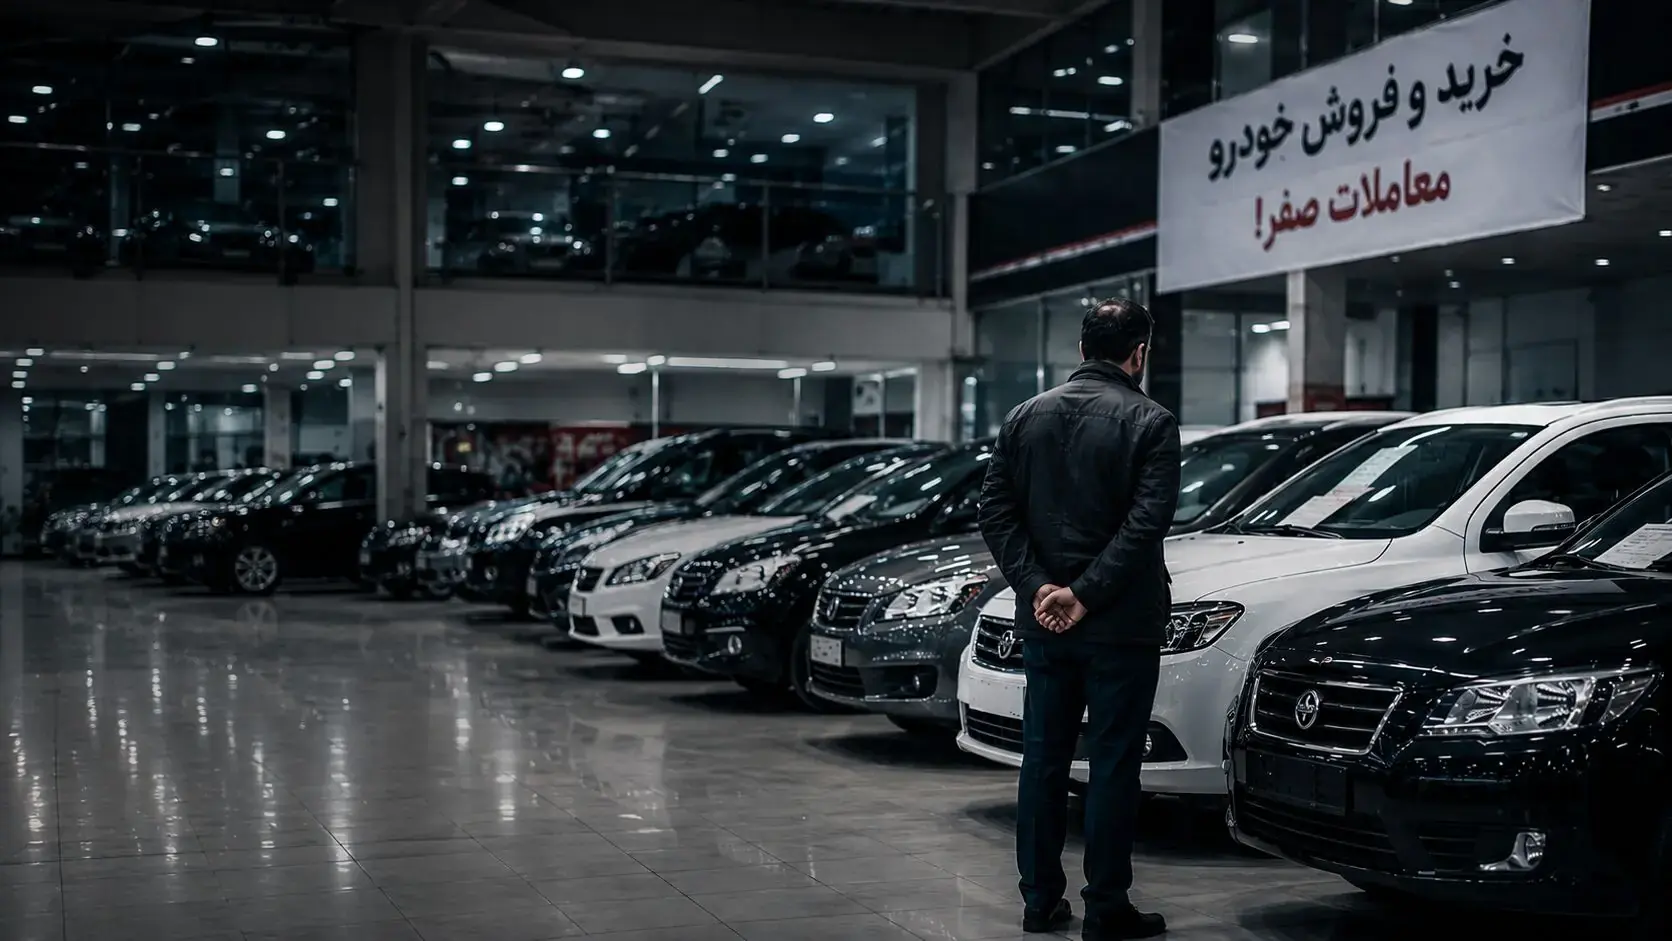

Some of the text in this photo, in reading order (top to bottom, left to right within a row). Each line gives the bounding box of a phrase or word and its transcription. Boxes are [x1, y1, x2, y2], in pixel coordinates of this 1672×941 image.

[1208, 32, 1525, 182] خرید و فروش خودرو
[1254, 160, 1451, 251] معاملات صفر!
